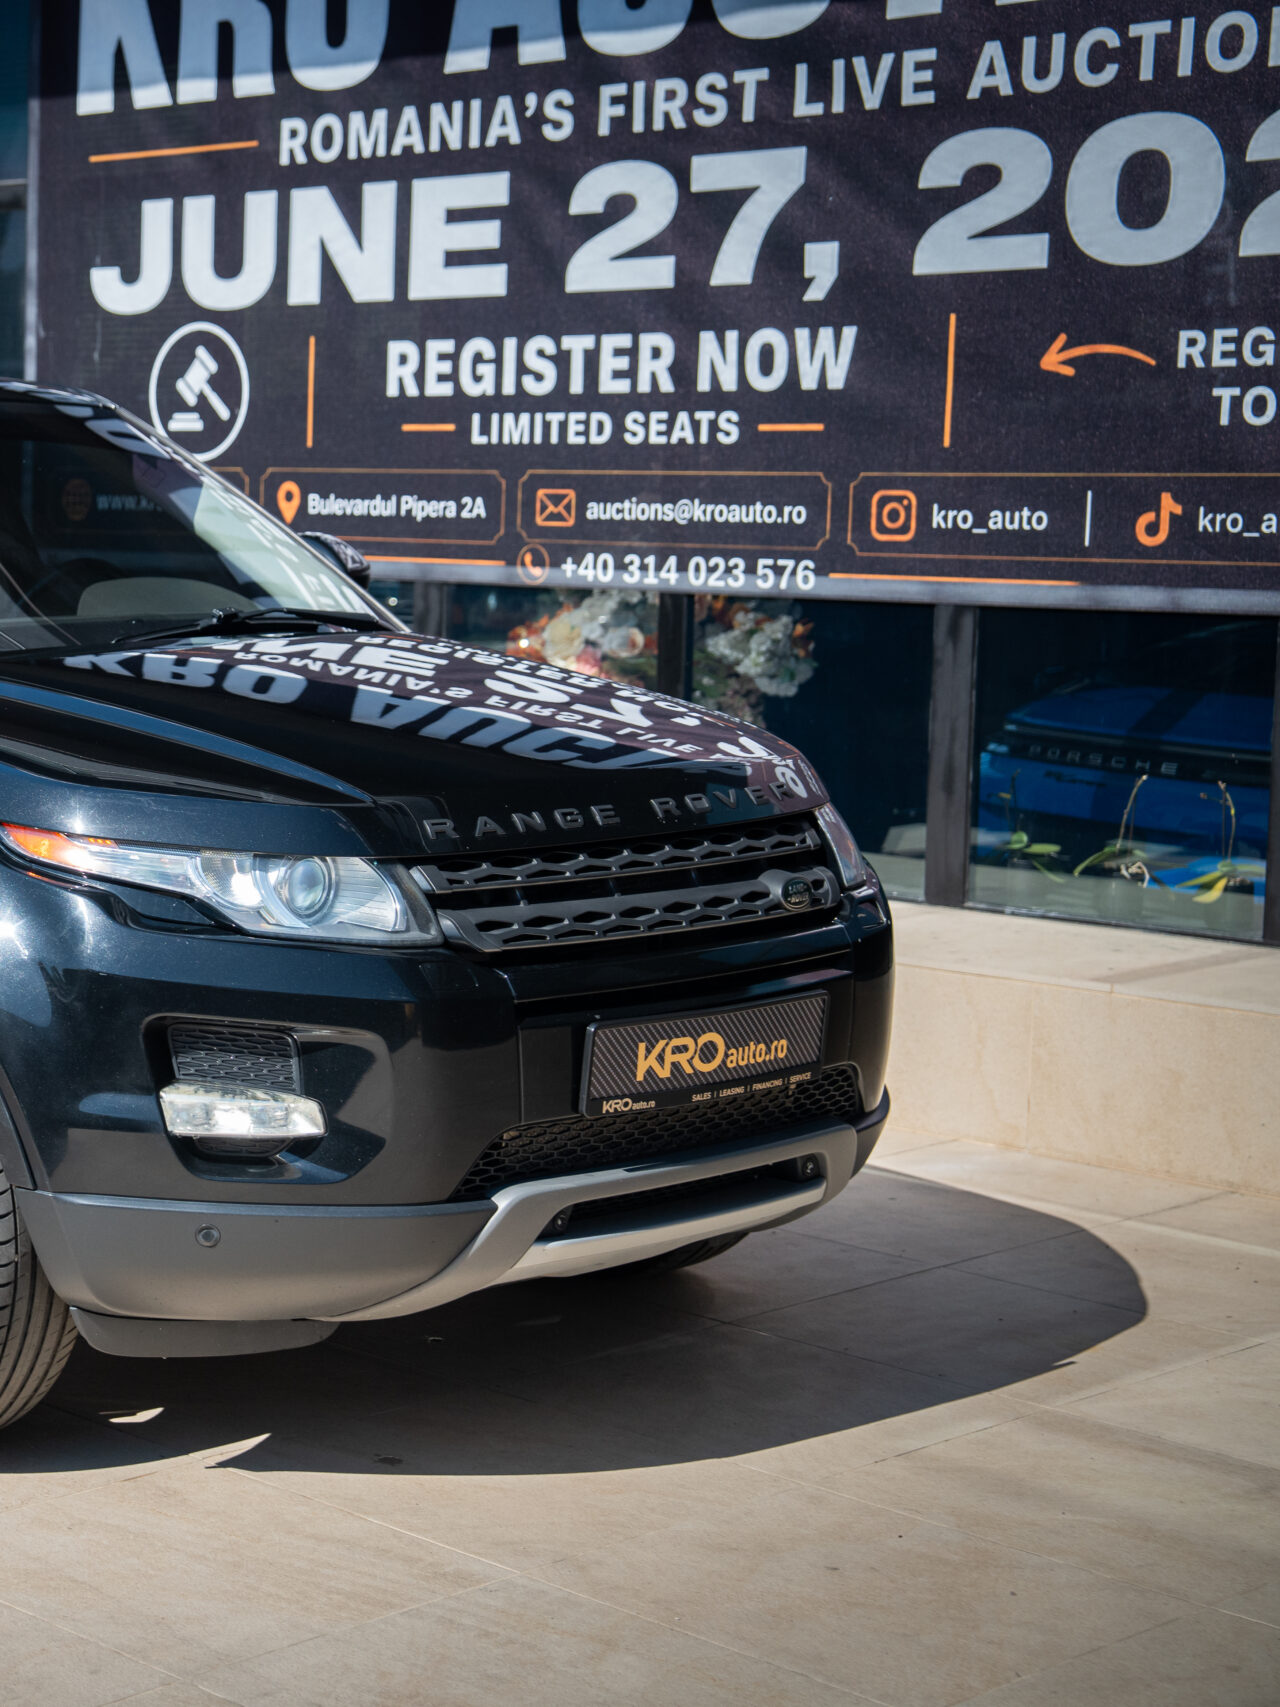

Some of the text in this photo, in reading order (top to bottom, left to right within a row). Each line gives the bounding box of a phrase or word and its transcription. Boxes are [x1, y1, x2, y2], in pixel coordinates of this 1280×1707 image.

[597, 67, 770, 137] FIRST
[792, 47, 938, 118] LIVE
[966, 6, 1280, 101] AUCTIO
[89, 171, 511, 316] JUNE
[564, 146, 841, 302] 27,
[386, 324, 859, 399] REGISTER NOW
[470, 410, 741, 446] LIMITED SEATS
[307, 493, 487, 523] Bulevardul Pipera 2A
[585, 497, 808, 525] auctions@kroauto.ro
[931, 502, 1049, 534] kro_auto
[560, 552, 817, 591] +40 314 023 576
[422, 781, 796, 841] RANGE ROVER
[691, 1072, 812, 1102] SALES LEASING FINANCING SERVICE
